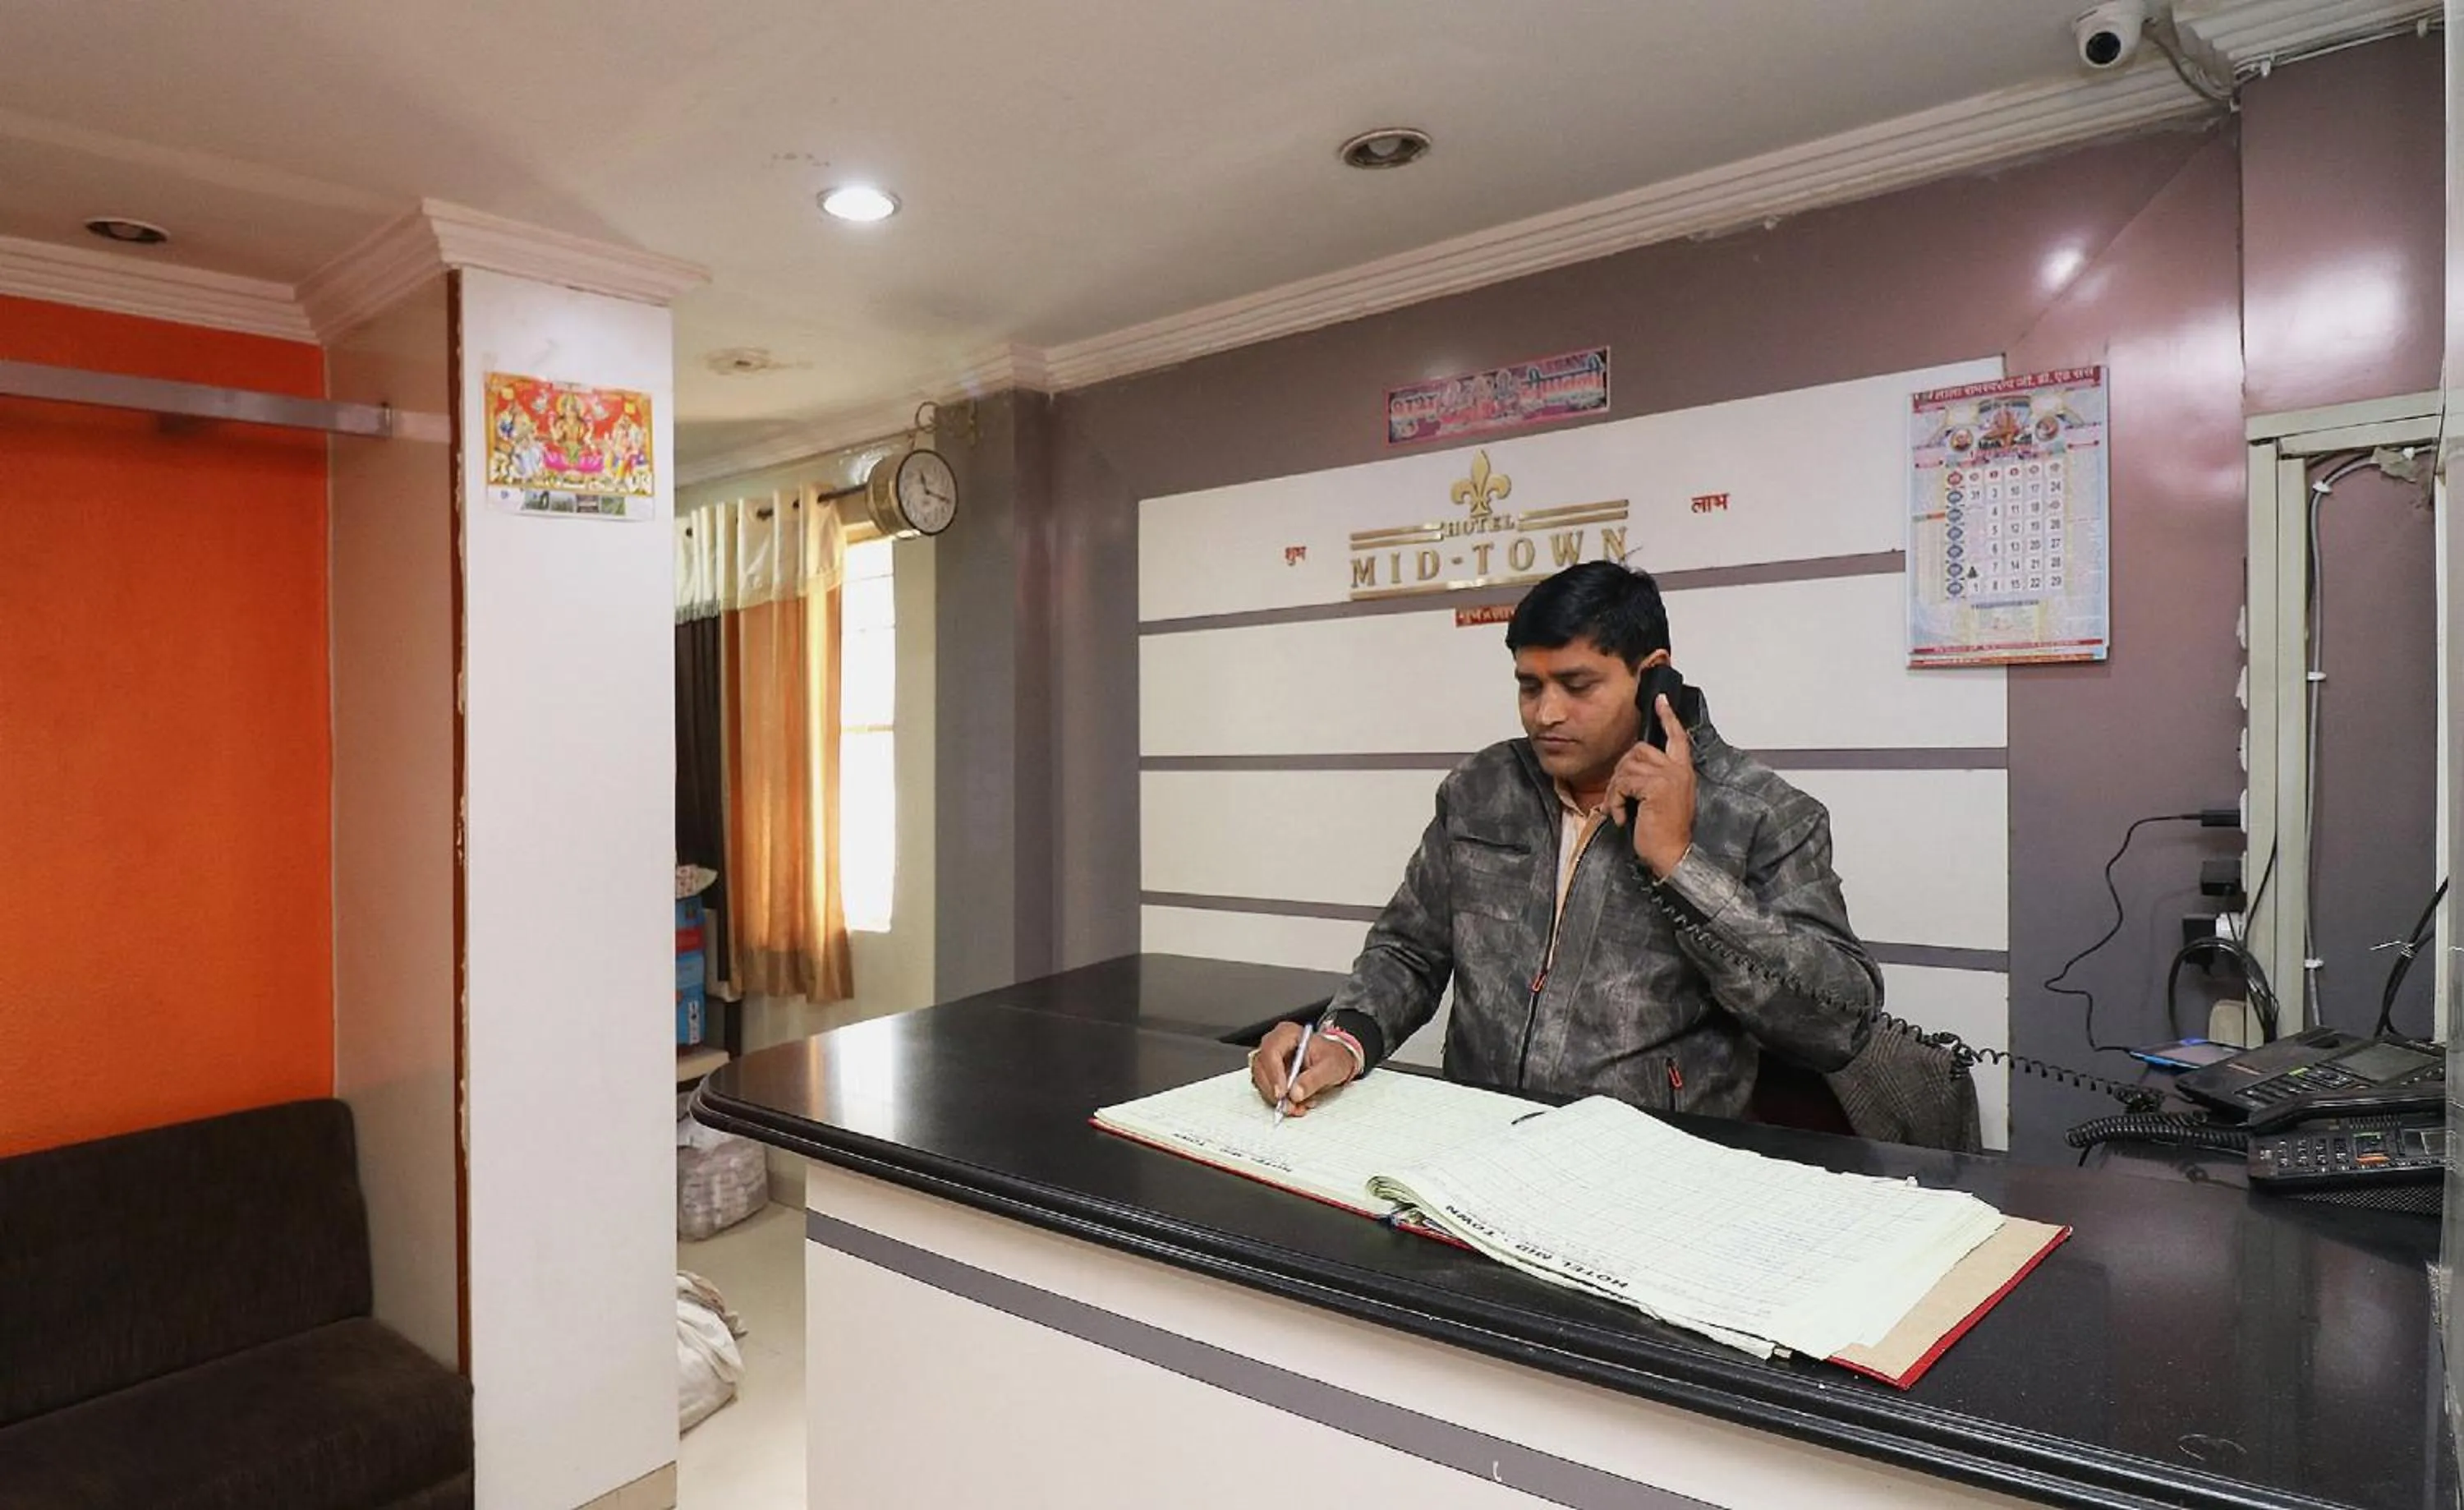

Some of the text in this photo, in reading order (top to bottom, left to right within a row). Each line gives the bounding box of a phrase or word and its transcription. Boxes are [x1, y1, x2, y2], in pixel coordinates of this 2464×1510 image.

[2050, 481, 2061, 493] 24
[1690, 492, 1731, 513] लाभ
[2011, 504, 2020, 514] 11
[1448, 515, 1516, 536] HOTEL
[2011, 523, 2020, 533] 12
[2011, 541, 2020, 551] 13
[2030, 539, 2041, 550] 20
[2051, 538, 2061, 548] 27
[2011, 560, 2020, 570] 14
[2030, 559, 2040, 569] 21
[2011, 579, 2020, 589] 15
[2030, 577, 2041, 588] 22
[2051, 576, 2062, 587] 29
[1445, 1204, 1629, 1289] HOTEL MID TOWN
